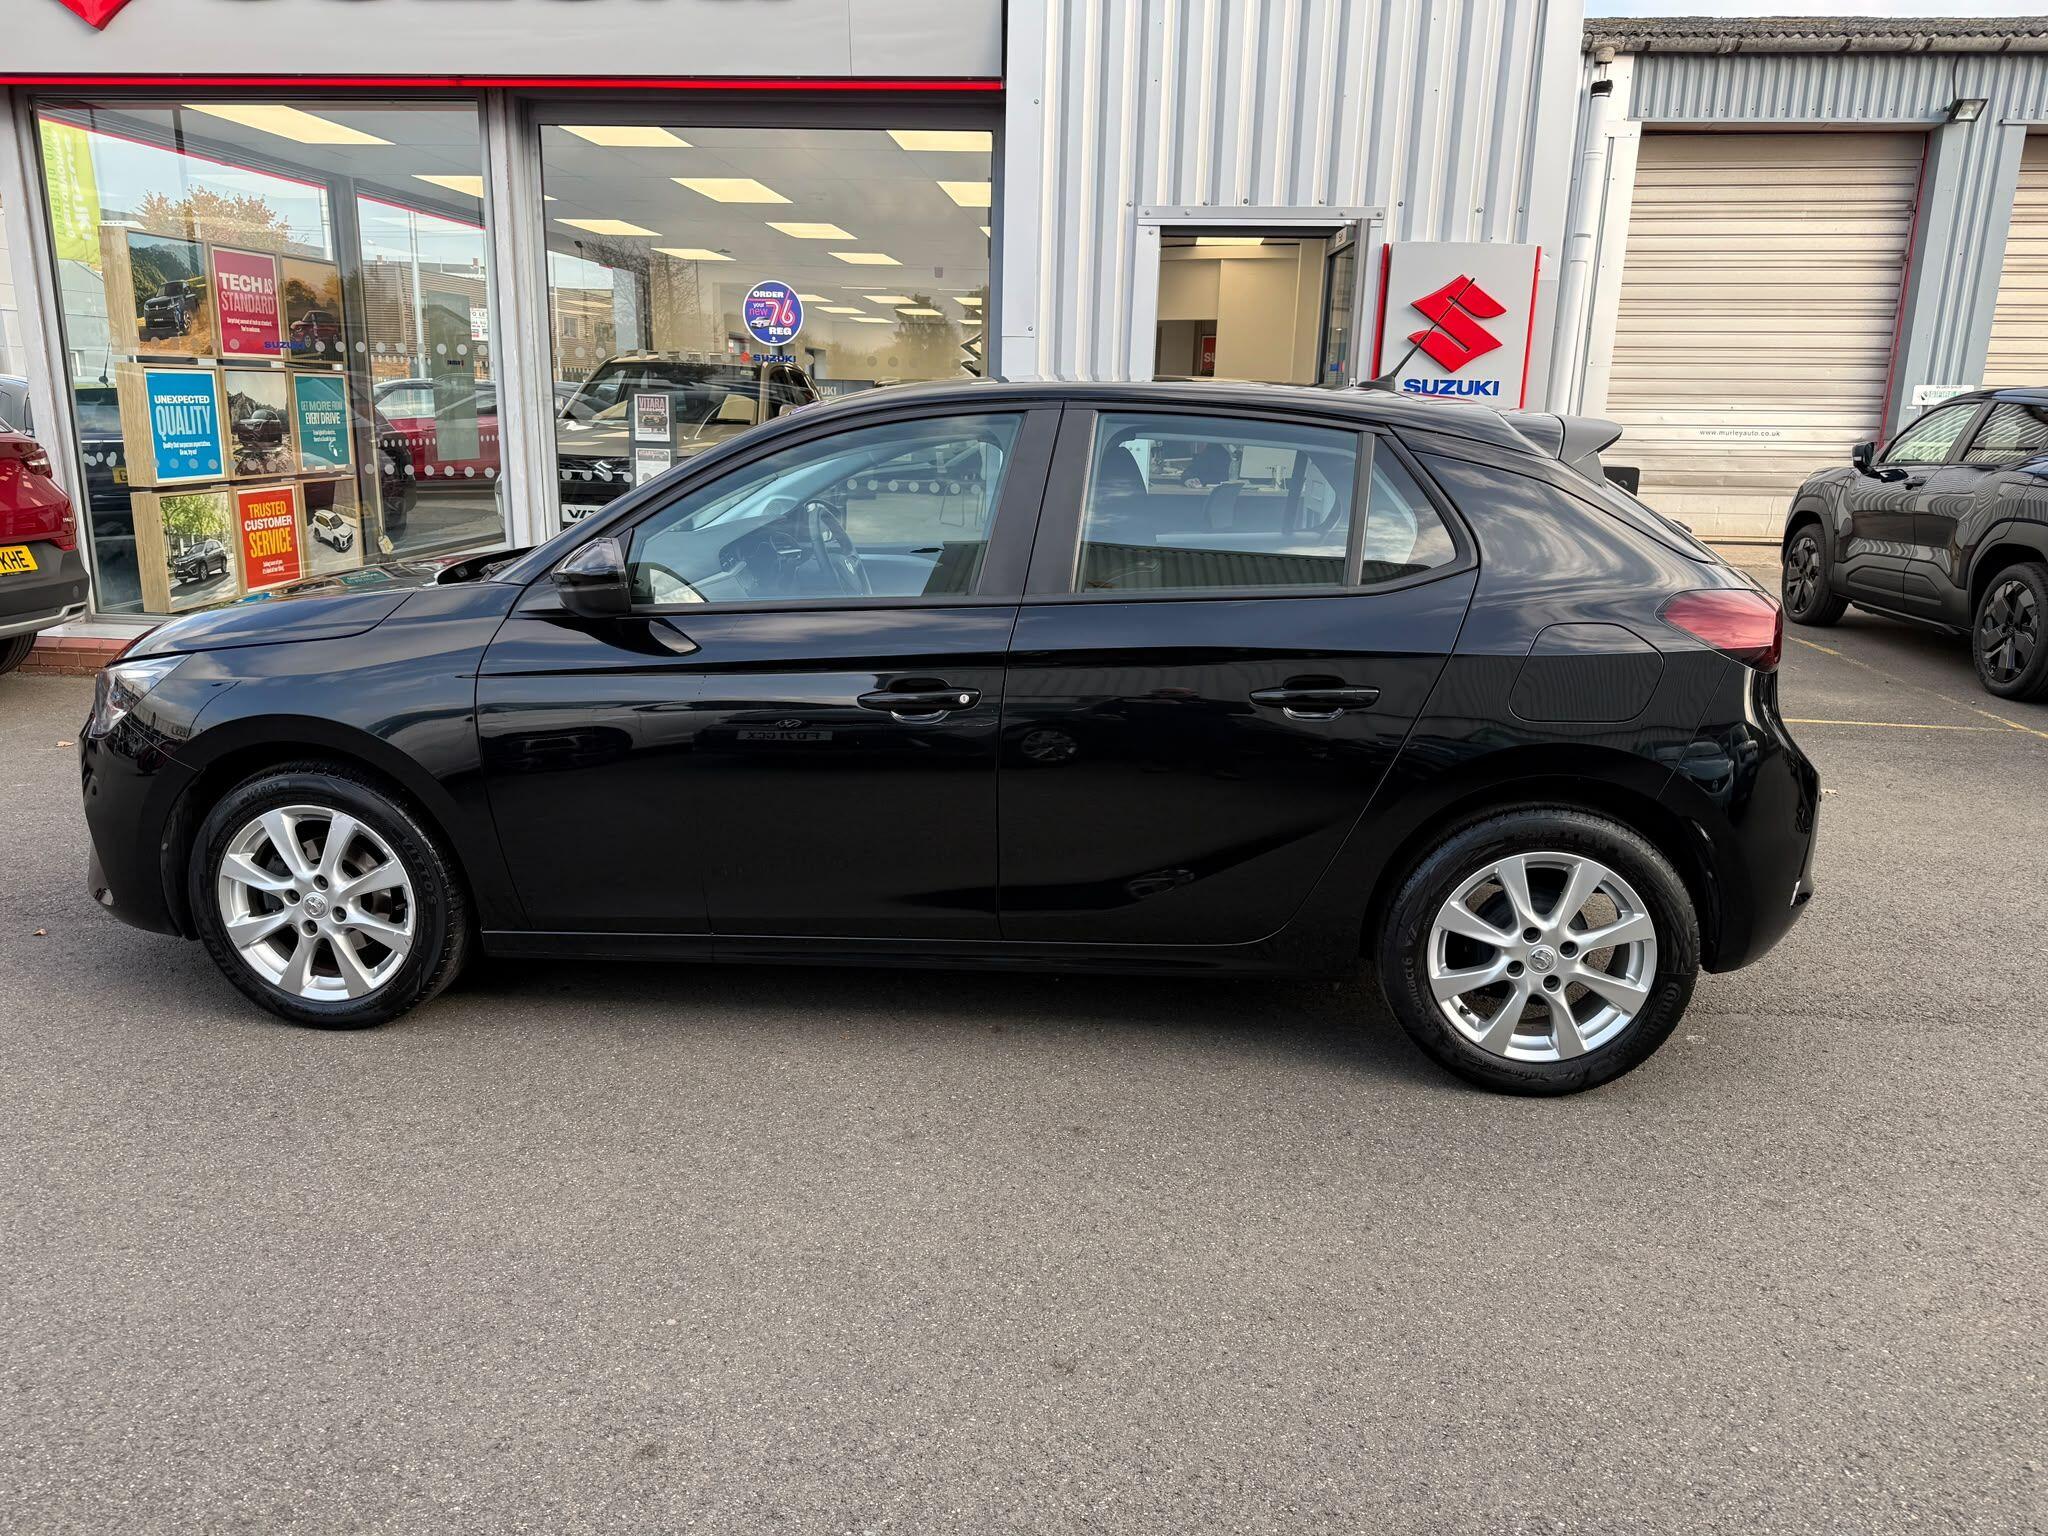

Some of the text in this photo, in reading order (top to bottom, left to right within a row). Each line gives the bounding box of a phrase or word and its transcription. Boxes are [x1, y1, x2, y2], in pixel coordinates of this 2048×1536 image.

[219, 272, 273, 294] TECH AS
[221, 291, 275, 315] STANDARD
[750, 308, 768, 316] new
[769, 327, 792, 335] REG
[264, 341, 305, 349] SUZUKI
[753, 354, 796, 362] SUZUKI
[1403, 379, 1500, 395] SUZUKI
[154, 395, 210, 404] UNEXPECTED
[310, 401, 331, 411] MORE
[639, 397, 665, 408] VITARA
[156, 405, 211, 441] QUALITY
[305, 412, 341, 425] EVERY DRIVE
[248, 501, 287, 519] TRUSTED
[567, 509, 595, 519] VI
[244, 515, 293, 532] CUSTOMER
[249, 526, 293, 558] SERVICE
[0, 550, 30, 570] KHE
